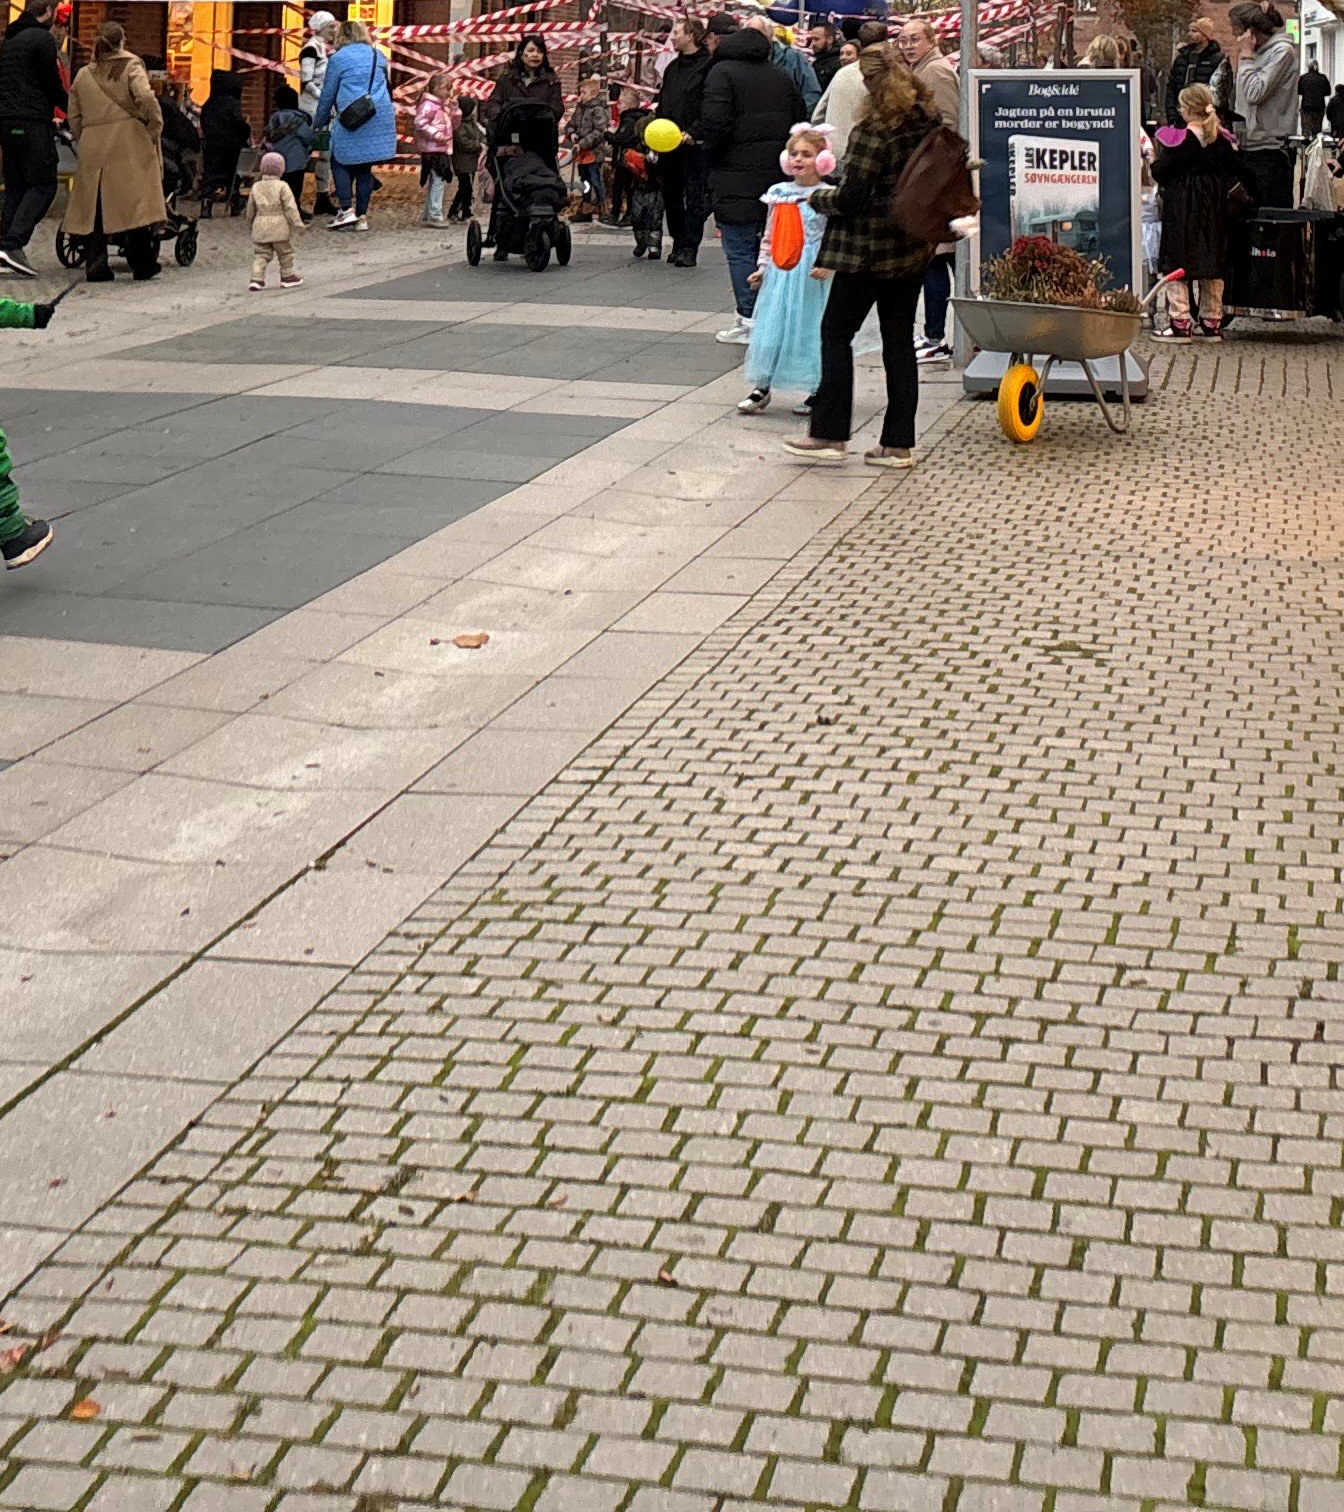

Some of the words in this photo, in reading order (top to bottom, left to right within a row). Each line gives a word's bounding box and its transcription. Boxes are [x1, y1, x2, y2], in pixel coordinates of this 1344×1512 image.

[1028, 83, 1080, 98] Bog&idé
[994, 106, 1037, 118] Jagten
[1039, 105, 1055, 118] på
[1056, 107, 1074, 117] en
[1075, 106, 1116, 117] brutal
[994, 118, 1044, 129] morder
[1044, 119, 1060, 129] er
[1061, 118, 1115, 130] begyndt
[1024, 146, 1035, 169] LARS
[1035, 147, 1097, 172] KEPLER
[1024, 172, 1098, 185] SØVNGÆNGEREN
